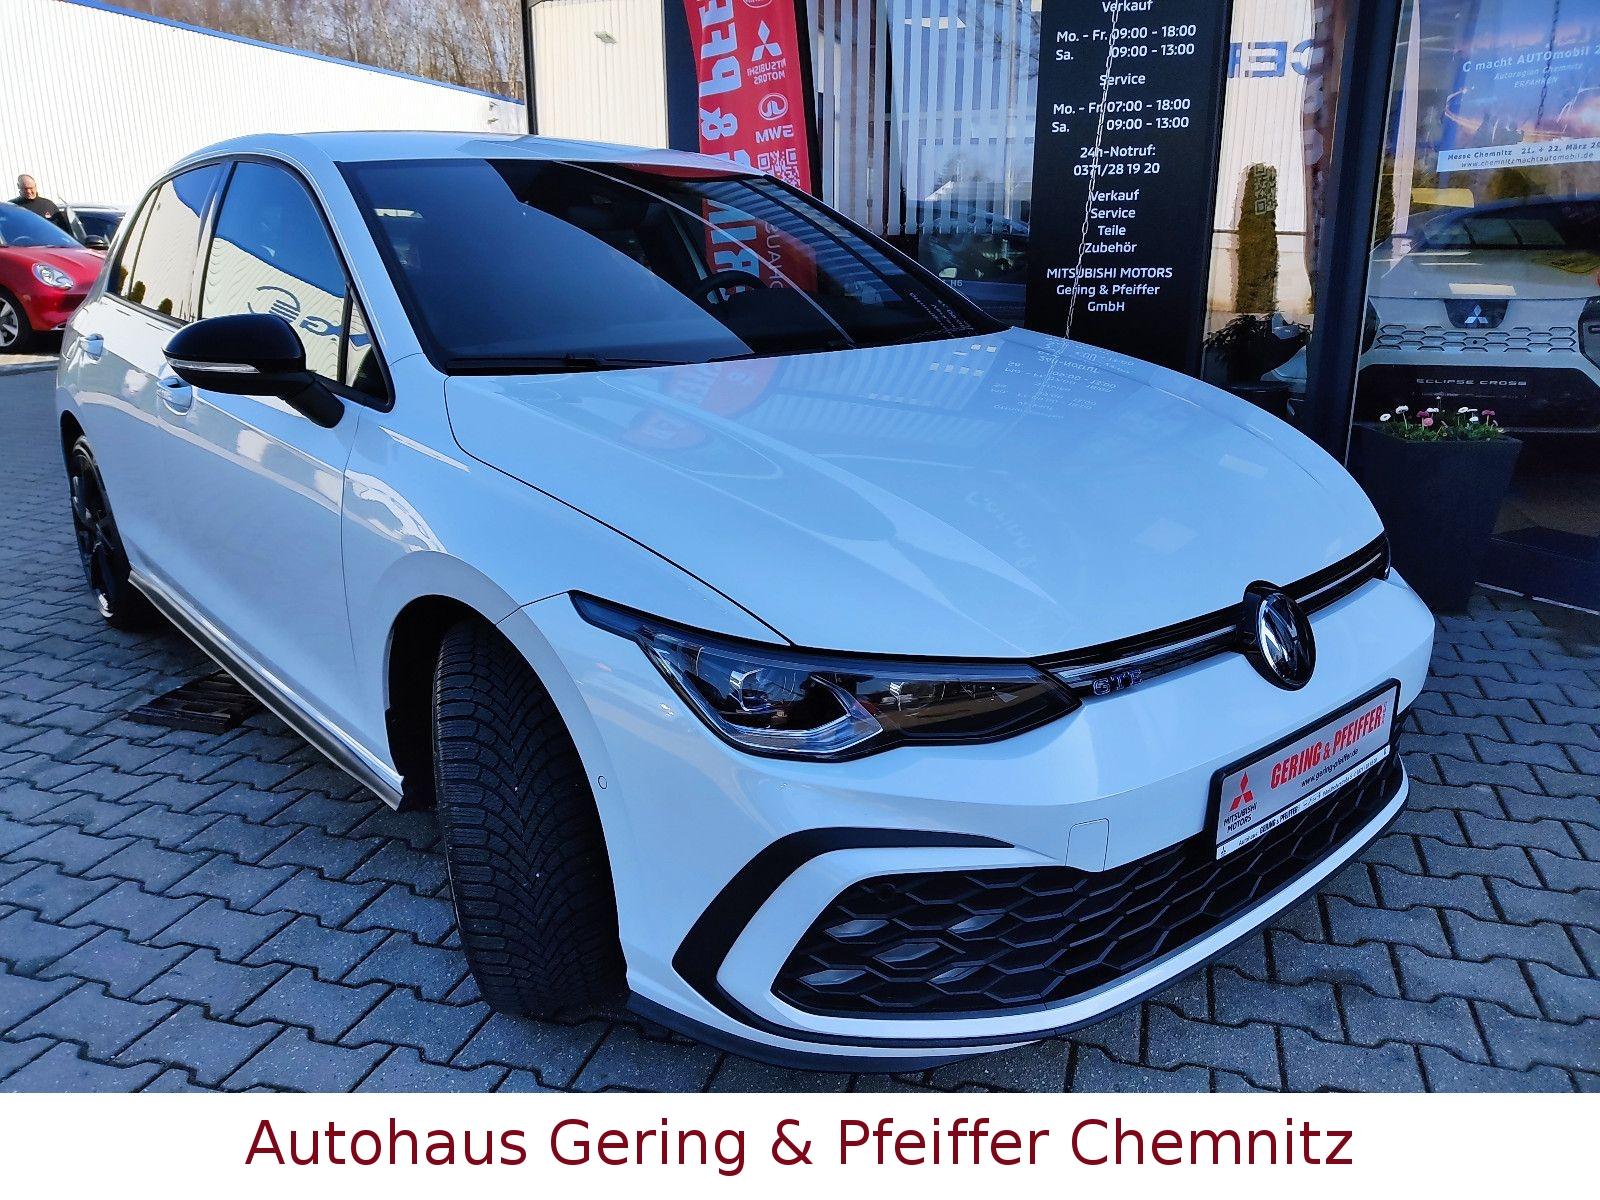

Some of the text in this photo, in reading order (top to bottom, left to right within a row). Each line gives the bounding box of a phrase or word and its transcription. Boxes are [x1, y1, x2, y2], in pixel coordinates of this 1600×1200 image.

[1102, 0, 1153, 13] Verkauf
[1056, 30, 1080, 43] Mo.
[1092, 29, 1108, 41] Fr.
[1111, 26, 1148, 40] 09:00
[1161, 24, 1197, 38] 18:00
[1055, 49, 1074, 61] Sa.
[1111, 45, 1148, 59] 09:00
[1160, 43, 1195, 56] 13:00
[1462, 60, 1473, 73] C
[1475, 56, 1513, 71] macht
[1100, 73, 1146, 86] Service
[1053, 103, 1076, 115] Mo.
[1106, 99, 1143, 113] 07:00
[1156, 98, 1191, 112] 18:00
[1051, 121, 1070, 133] Sa.
[1106, 118, 1143, 131] 09:00
[1155, 116, 1190, 129] 13:00
[1080, 144, 1156, 159] 24h-Notruf:
[1473, 150, 1513, 160] Chemnitz
[1073, 162, 1160, 177] 0371/28 19 20
[1090, 189, 1140, 201] Verkauf
[1090, 207, 1136, 219] Service
[1098, 225, 1126, 236] Teile
[1085, 242, 1137, 254] Zubehör
[1046, 267, 1173, 279] MITSUBISHI MOTORS
[1056, 284, 1160, 297] Gering & Pfeiffer
[1087, 301, 1125, 312] GmbH
[1270, 741, 1323, 790] GERING
[1322, 742, 1331, 761] &
[1333, 704, 1384, 755] PFEIFFER
[1223, 802, 1258, 827] MITSUBISHI
[1227, 815, 1252, 834] MOTORS
